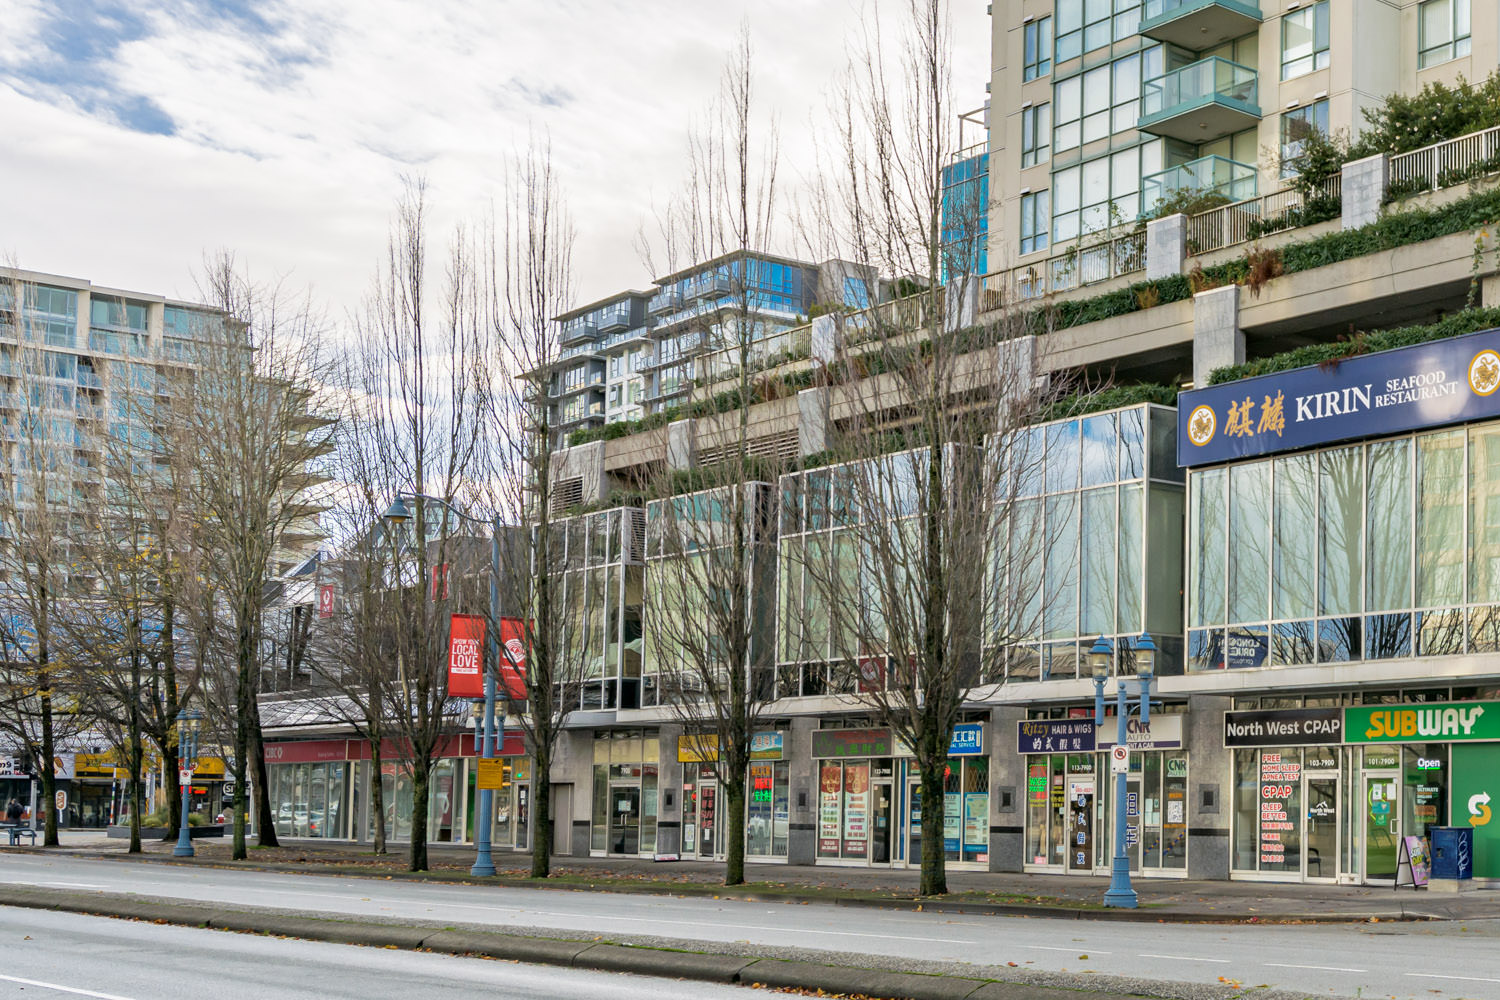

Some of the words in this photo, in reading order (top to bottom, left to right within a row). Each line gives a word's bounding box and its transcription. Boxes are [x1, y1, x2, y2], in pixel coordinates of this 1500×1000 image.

[1386, 370, 1446, 393] SEAFOOD
[1375, 381, 1458, 408] RESTAURANT
[1295, 384, 1372, 422] KIRIN
[1224, 389, 1285, 438] 麒麟
[452, 644, 478, 655] LOCAL
[451, 655, 478, 667] LOVE
[1127, 719, 1151, 734] CNR
[1227, 721, 1263, 737] North
[1266, 721, 1300, 735] West
[1303, 719, 1340, 734] CPAP
[1365, 705, 1485, 740] SUBWAY
[1023, 722, 1049, 738] Ritzy
[1051, 725, 1067, 735] HAIR
[1074, 723, 1092, 734] WIGS
[1127, 733, 1151, 741] AUTO
[1262, 754, 1281, 763] FREE
[1417, 757, 1440, 768] Open
[1169, 759, 1187, 771] CNR
[1262, 764, 1280, 773] HOME
[1281, 763, 1300, 773] SLEEP
[1262, 773, 1282, 781] APNEA
[1284, 773, 1299, 781] TEST
[1262, 785, 1292, 798] CPAP
[1262, 803, 1282, 811] SLEEP
[1262, 812, 1287, 821] BETTER
